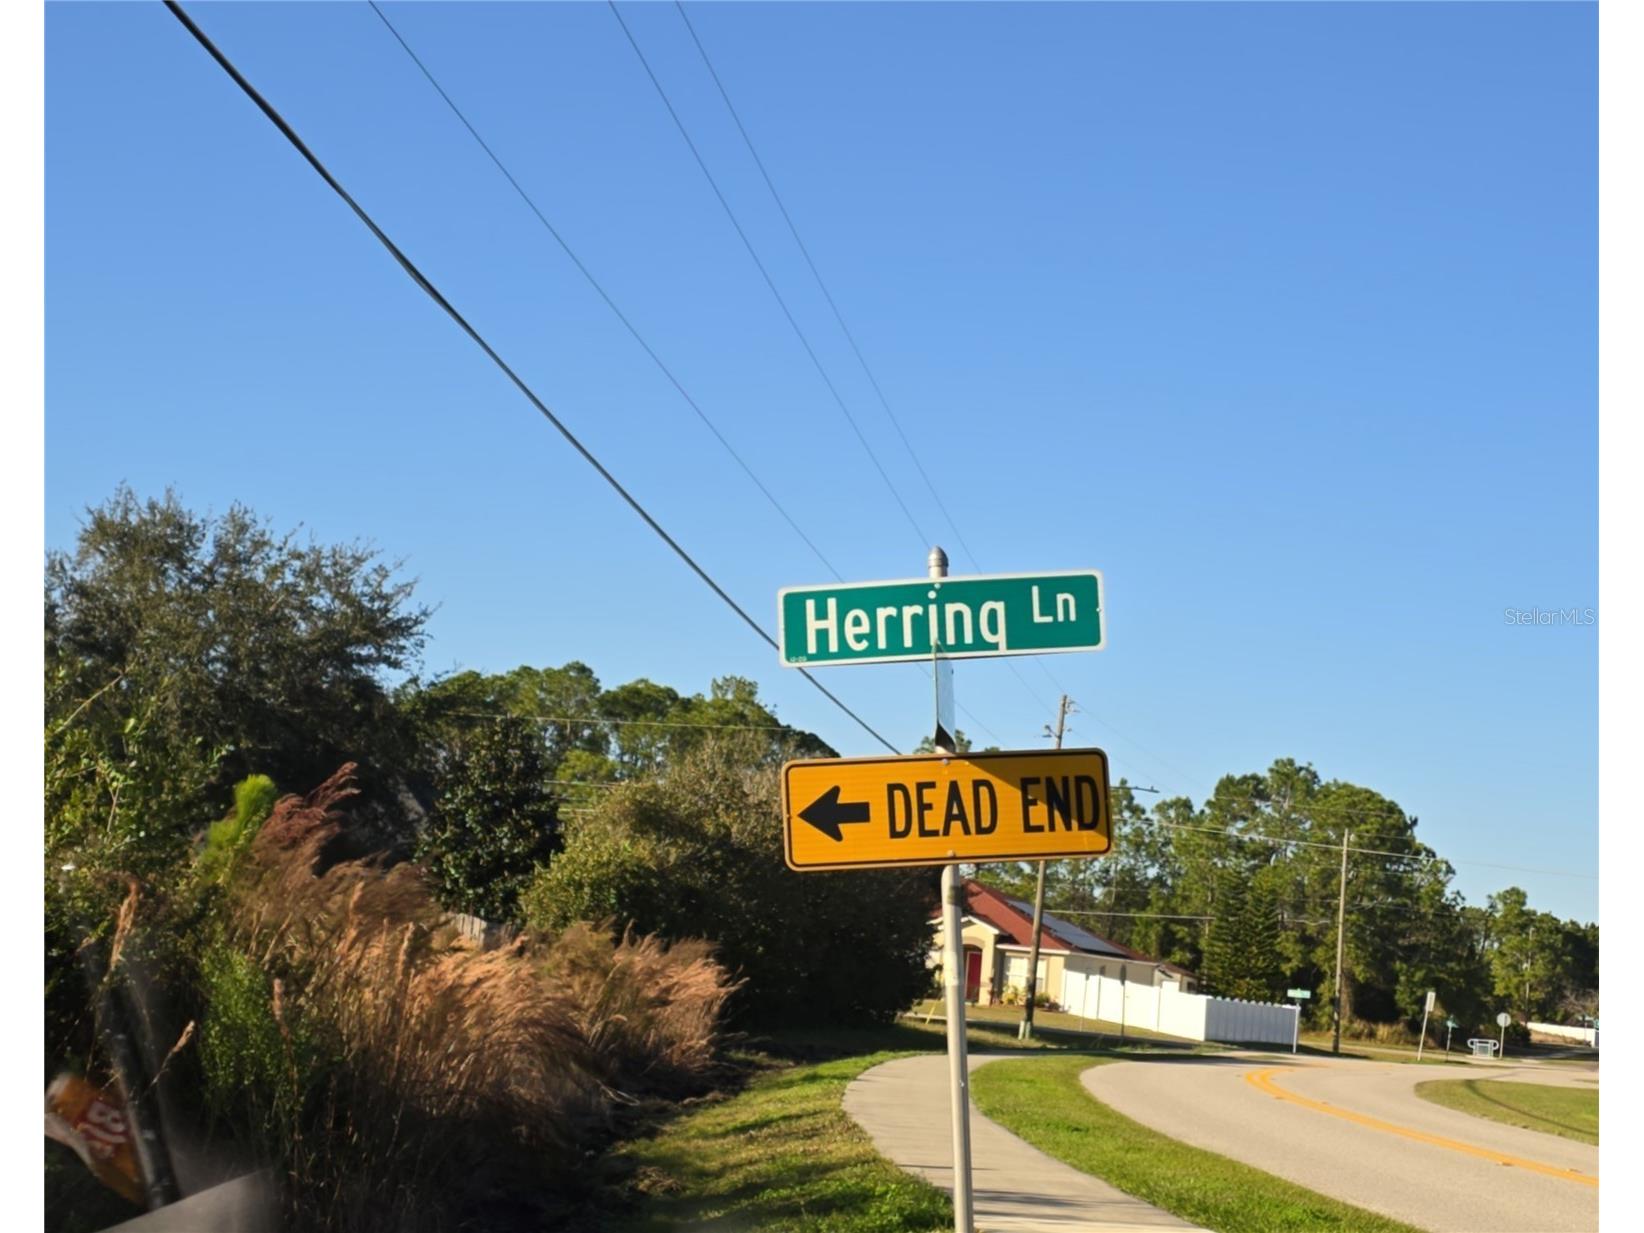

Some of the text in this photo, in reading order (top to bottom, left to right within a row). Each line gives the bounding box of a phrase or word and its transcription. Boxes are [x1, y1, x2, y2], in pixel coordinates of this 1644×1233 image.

[1032, 585, 1076, 624] Ln
[886, 774, 1100, 839] DEAD END
